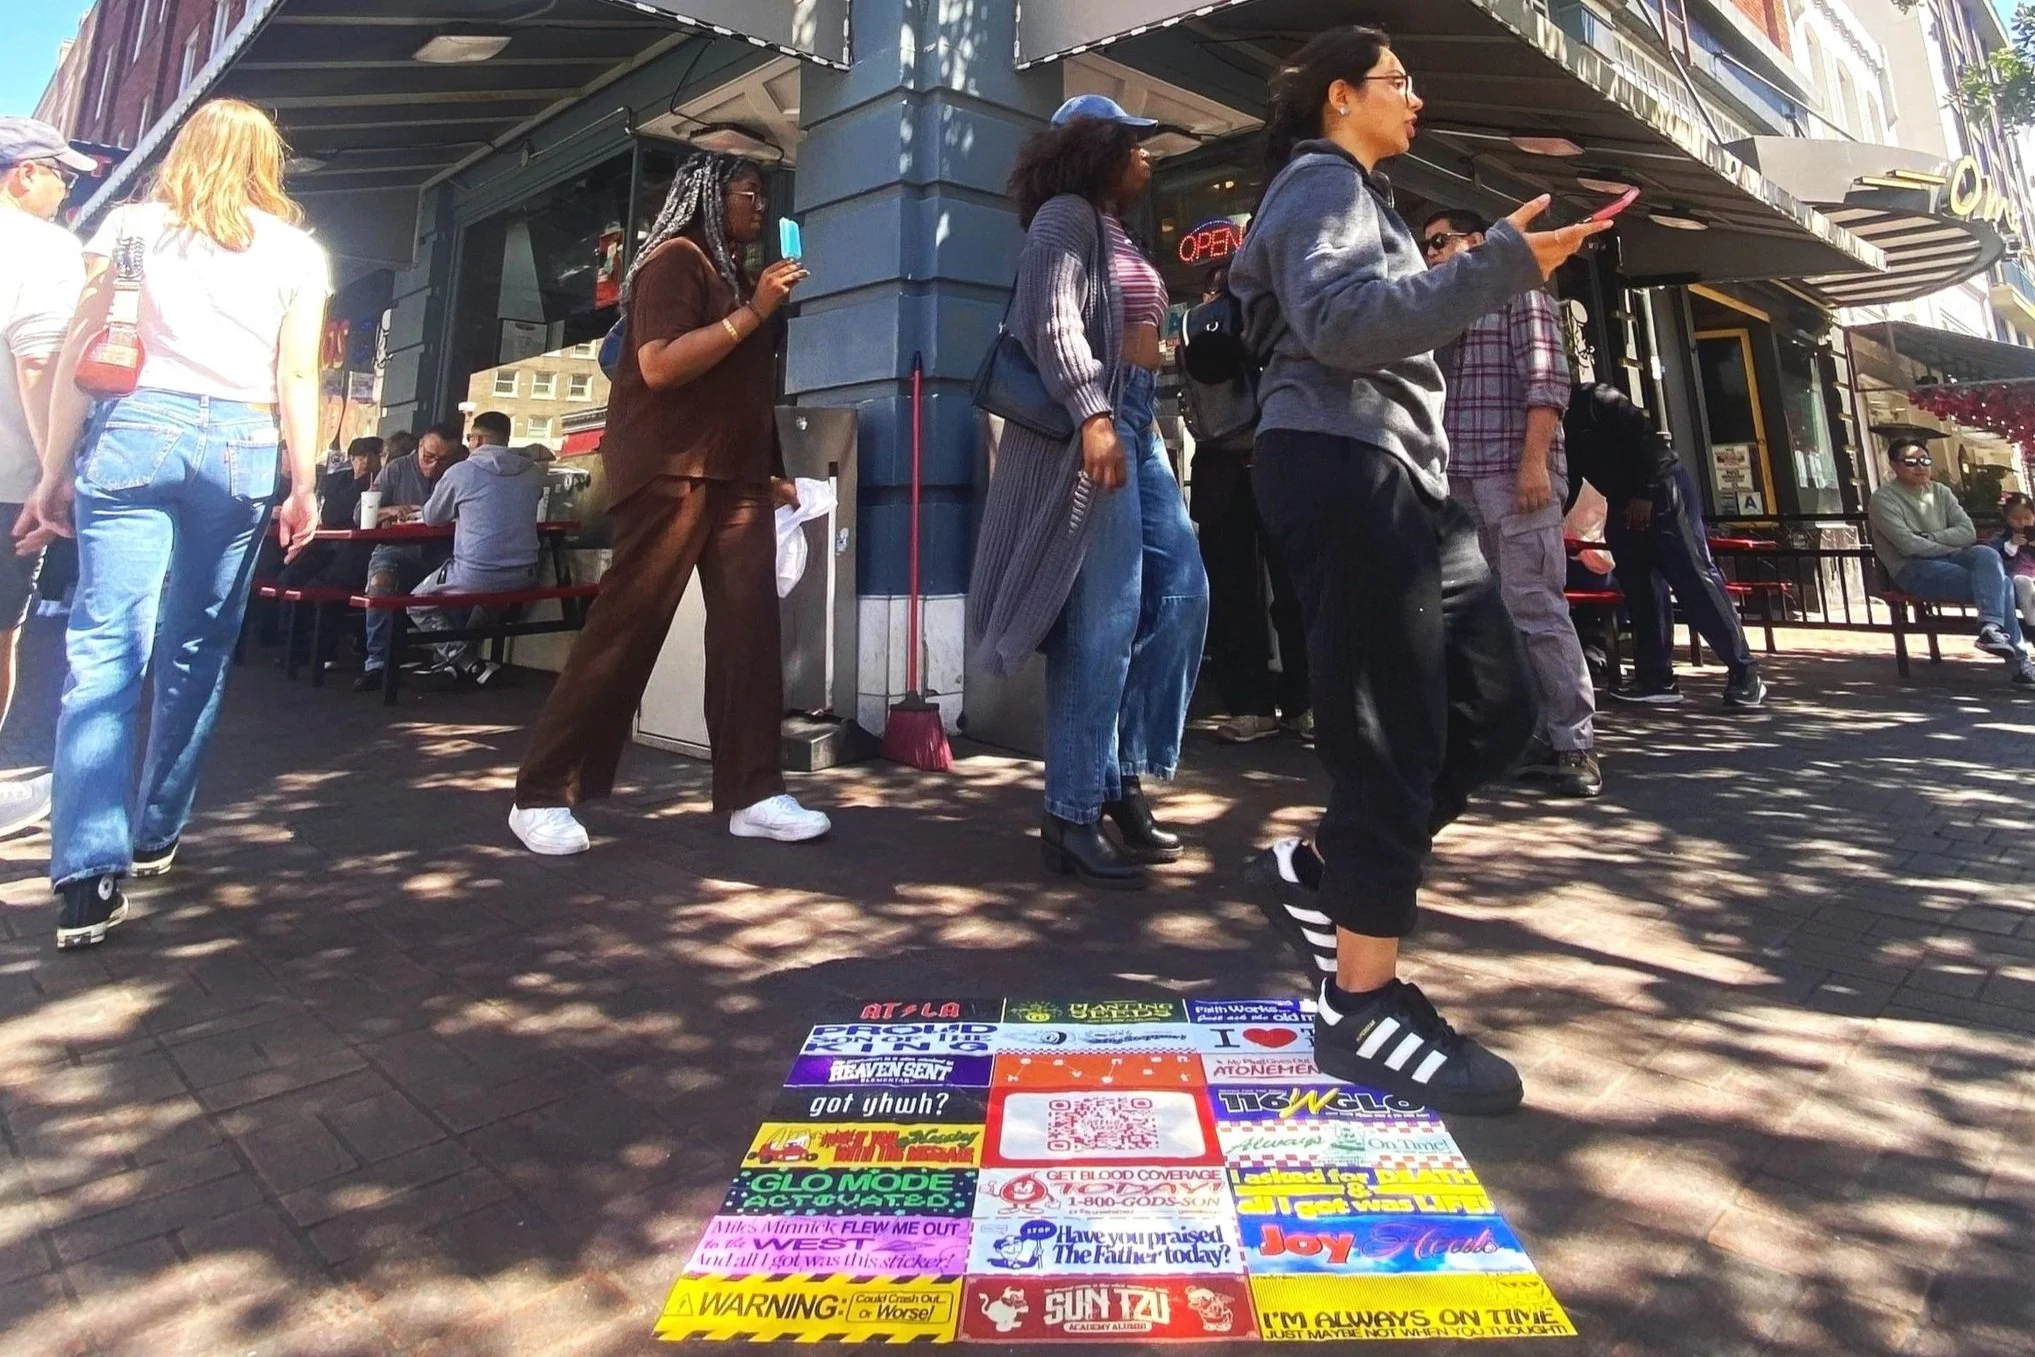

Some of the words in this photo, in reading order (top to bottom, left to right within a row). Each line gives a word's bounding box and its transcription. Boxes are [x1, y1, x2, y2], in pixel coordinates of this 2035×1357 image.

[1179, 224, 1244, 262] OPEN
[1744, 495, 1758, 509] A
[1195, 1005, 1227, 1013] Faith
[1273, 1013, 1299, 1022] old
[811, 1035, 873, 1043] SON
[881, 1035, 922, 1043] OF
[938, 1032, 993, 1042] THE
[812, 1024, 998, 1036] PROUD
[1209, 1028, 1240, 1048] I
[804, 1041, 989, 1052] KING
[828, 1060, 904, 1082] HEAVEN
[902, 1059, 954, 1081] SENT
[1213, 1064, 1319, 1076] ATONEMEN
[809, 1092, 853, 1117] got
[862, 1092, 949, 1117] yhwh?
[1226, 1134, 1325, 1153] Always
[1368, 1138, 1398, 1150] On
[1401, 1137, 1450, 1152] Time!
[751, 1173, 833, 1191] GLO
[837, 1173, 956, 1191] MODE
[1046, 1169, 1078, 1180] GET
[1080, 1169, 1134, 1180] BLOOD
[1137, 1169, 1222, 1180] COVERAGE
[1228, 1168, 1240, 1184] I
[1243, 1168, 1325, 1185] asked
[1327, 1168, 1370, 1184] for
[1053, 1182, 1224, 1196] TODAY!
[1345, 1181, 1376, 1198] &
[743, 1193, 950, 1208] ACTIVATED
[1067, 1196, 1220, 1207] 1-800-GODS-SON
[1237, 1195, 1276, 1215] all
[1276, 1196, 1292, 1214] I
[1294, 1199, 1350, 1220] got
[1350, 1199, 1413, 1213] was
[712, 1220, 758, 1234] Miles
[761, 1220, 840, 1234] Minnick
[841, 1220, 889, 1235] FLEW
[892, 1221, 919, 1235] ME
[923, 1222, 960, 1236] OUT
[1027, 1226, 1051, 1234] STOP
[704, 1240, 721, 1249] to
[725, 1238, 746, 1249] the
[752, 1237, 876, 1250] WEST
[1056, 1225, 1107, 1244] Have
[1107, 1231, 1145, 1248] you
[1147, 1225, 1224, 1249] praised
[697, 1252, 732, 1267] And
[732, 1252, 758, 1267] all
[759, 1252, 768, 1267] I
[770, 1253, 801, 1270] got
[805, 1255, 840, 1267] was
[844, 1252, 877, 1268] this
[880, 1252, 955, 1270] sticker!
[1053, 1244, 1092, 1264] The
[1093, 1244, 1162, 1264] Father
[1164, 1244, 1232, 1268] today?
[699, 1291, 847, 1320] WARNING:
[855, 1293, 887, 1304] Could
[889, 1293, 919, 1304] Crash
[875, 1303, 935, 1320] Worse!
[1043, 1287, 1111, 1325] SUN
[1112, 1288, 1171, 1325] TZU
[1262, 1311, 1306, 1329] I'M
[1315, 1310, 1431, 1328] ALWAYS
[1439, 1309, 1481, 1327] ON
[1485, 1308, 1559, 1325] TIME
[1068, 1323, 1111, 1331] ACADEMY
[1265, 1328, 1305, 1339] JUST
[1307, 1327, 1363, 1339] MAYBE
[1365, 1327, 1400, 1339] NOT
[1401, 1327, 1449, 1338] WHEN
[1452, 1326, 1485, 1337] YOU
